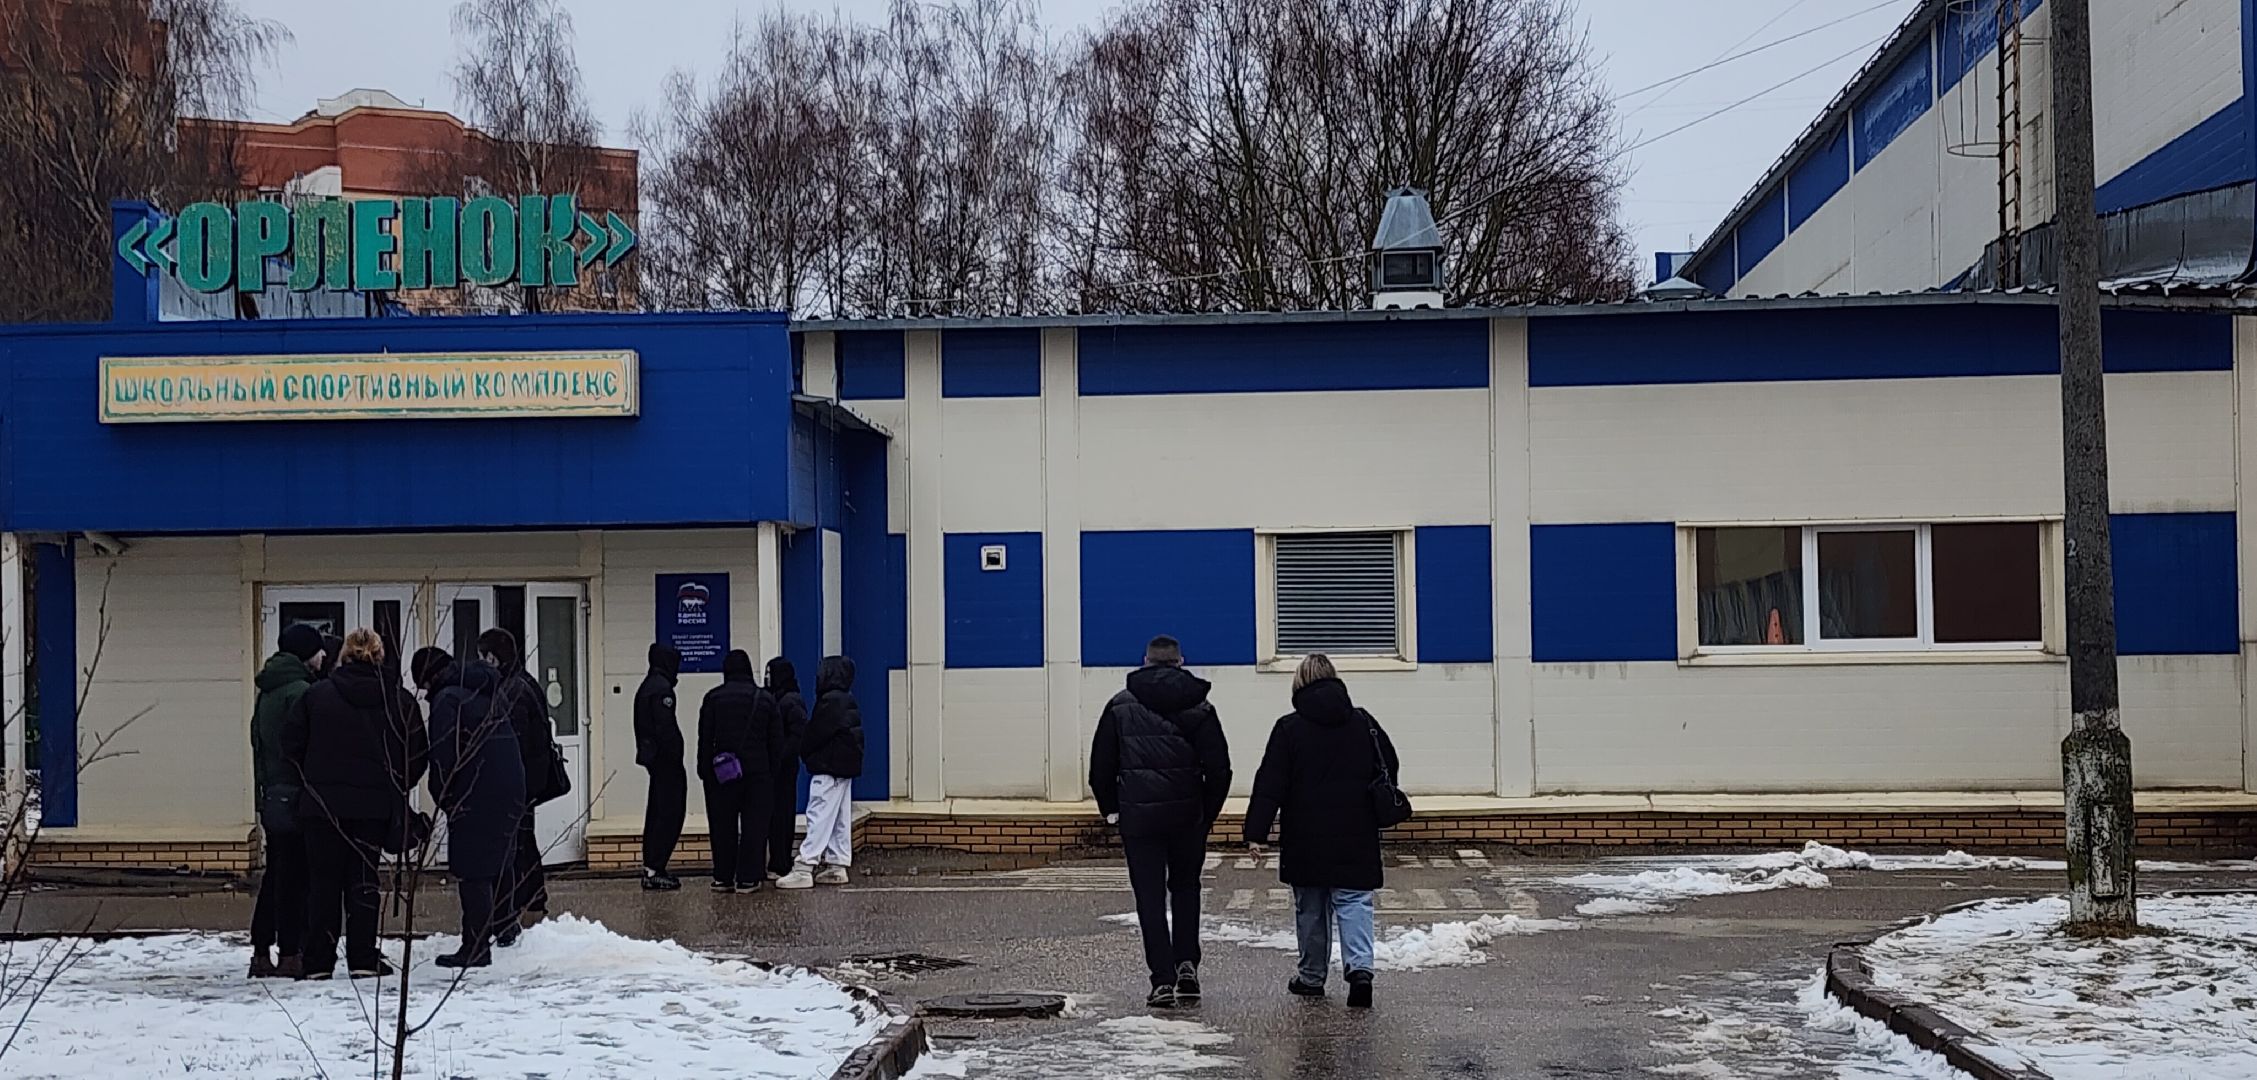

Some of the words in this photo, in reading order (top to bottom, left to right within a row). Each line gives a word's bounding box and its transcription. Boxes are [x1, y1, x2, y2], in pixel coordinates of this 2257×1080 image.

[117, 195, 637, 294] «ОРЛЕНОК»
[114, 368, 277, 402] ШКОЛЬНЫЙ
[283, 367, 466, 401] СПОРТИВНЫЙ
[473, 369, 618, 400] КОМПЛЕКС
